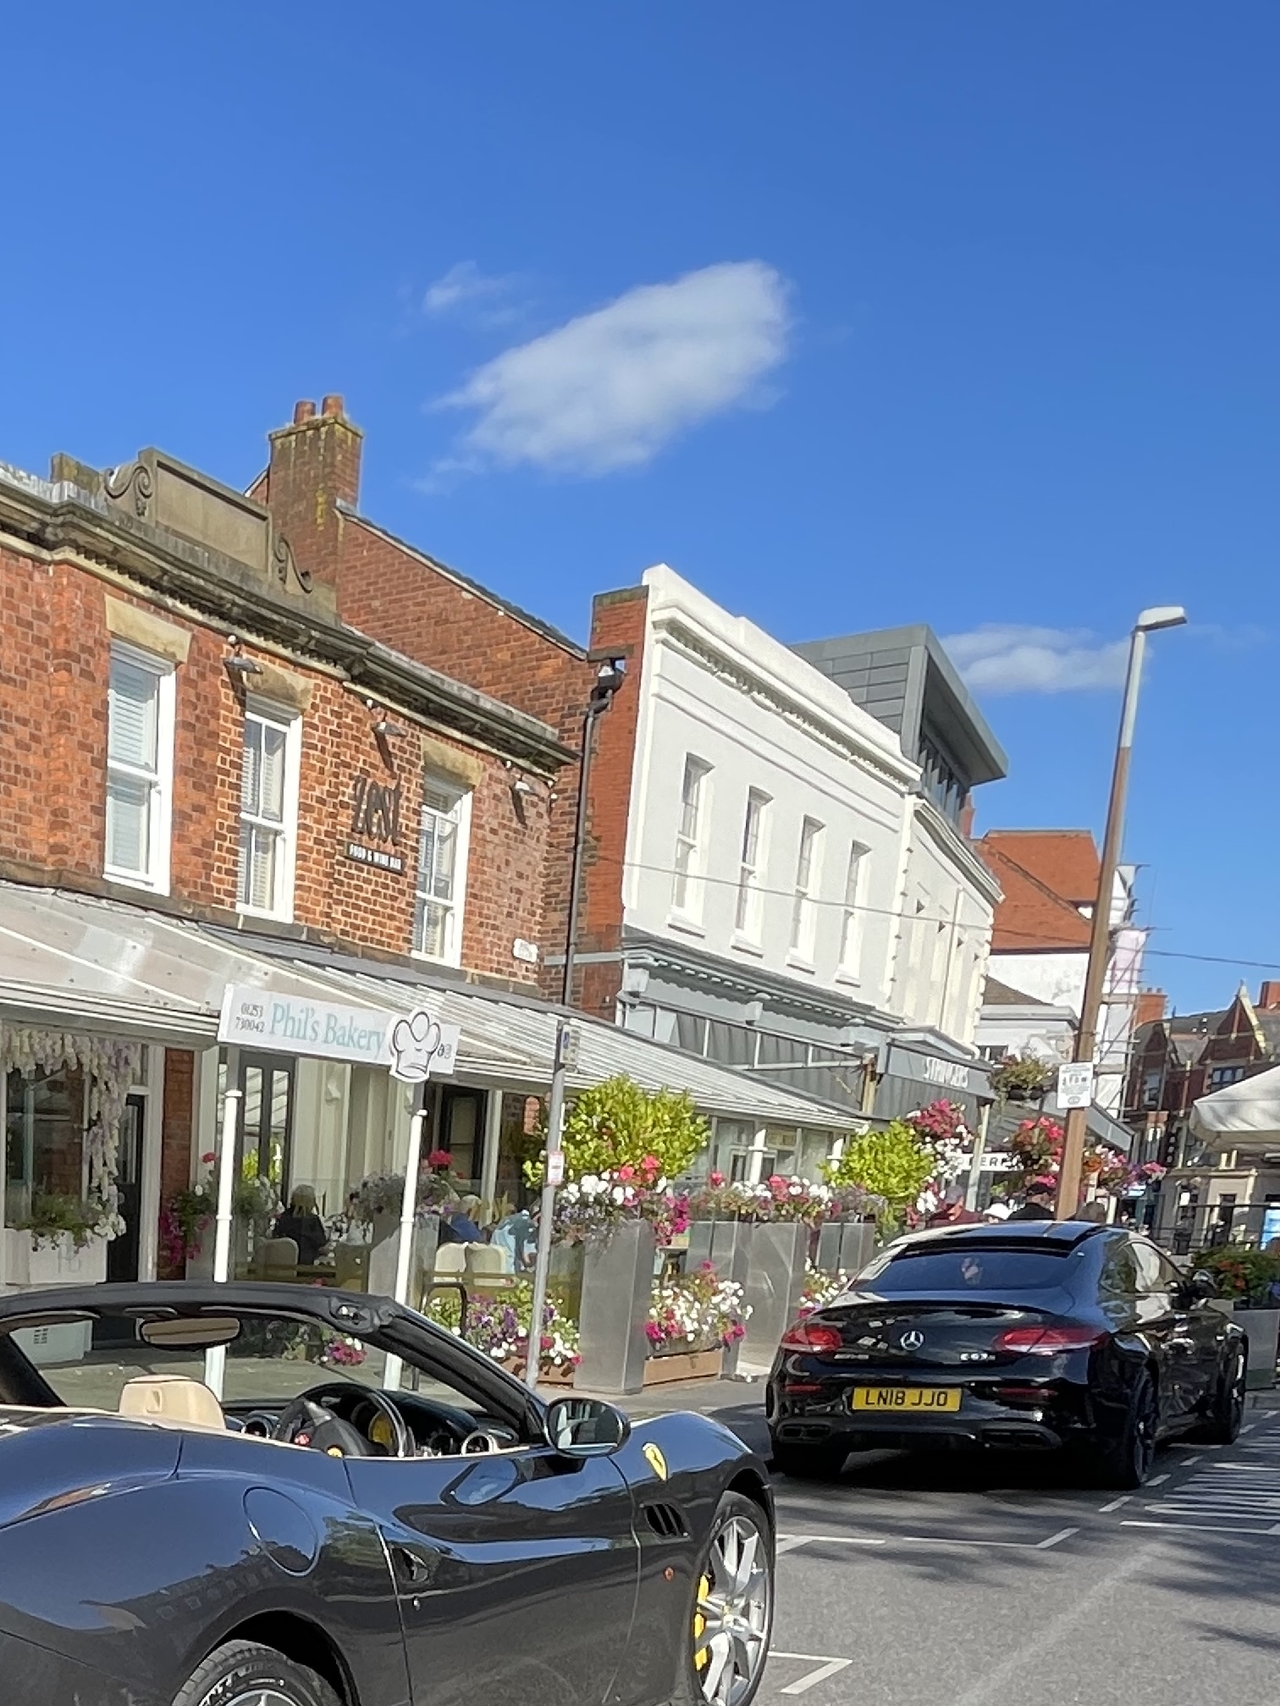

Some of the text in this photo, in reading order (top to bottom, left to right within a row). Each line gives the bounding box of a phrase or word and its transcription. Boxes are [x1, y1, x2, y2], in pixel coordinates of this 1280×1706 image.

[269, 1002, 387, 1059] Phil's Bakery
[865, 1390, 948, 1407] LN18 JJO
